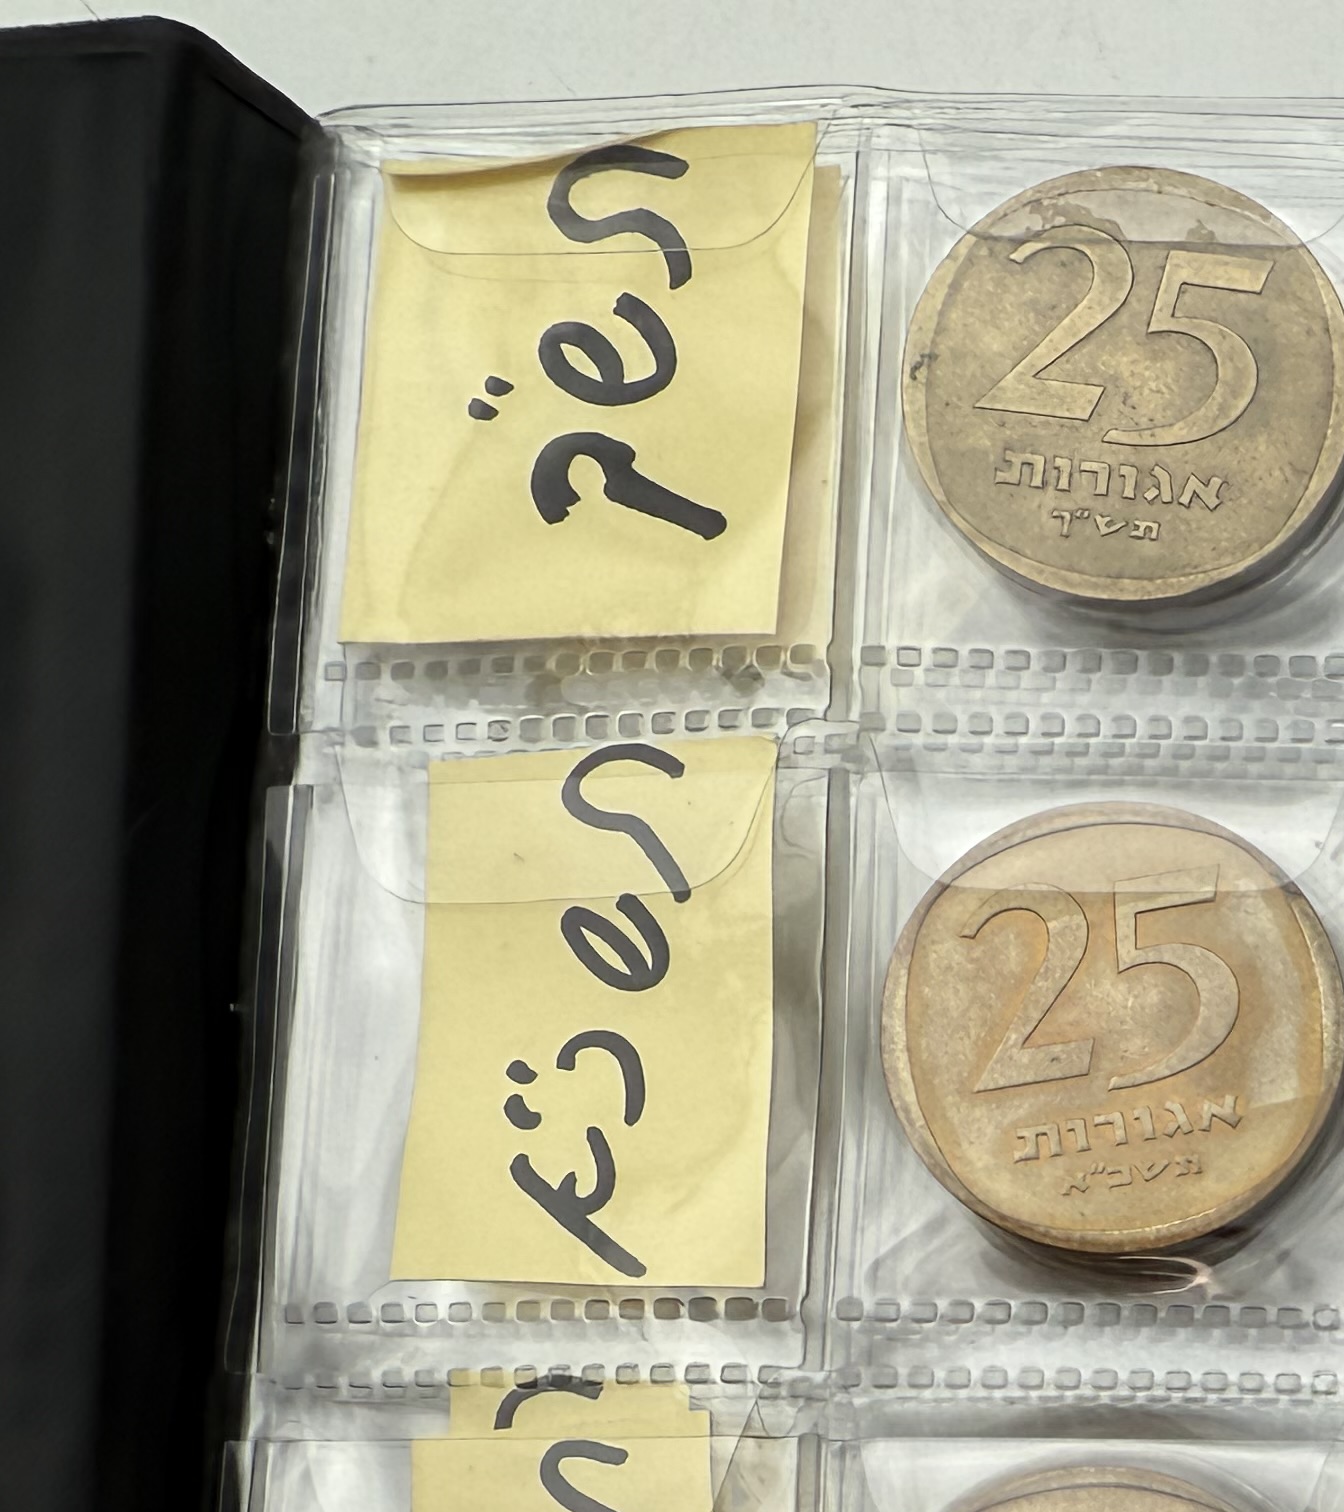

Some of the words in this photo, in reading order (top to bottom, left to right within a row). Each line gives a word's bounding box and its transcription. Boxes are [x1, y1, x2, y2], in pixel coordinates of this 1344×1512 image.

[972, 222, 1276, 448] 25
[994, 449, 1229, 512] אגורות
[959, 862, 1241, 1093] 25
[1012, 1093, 1245, 1164] אגורות
